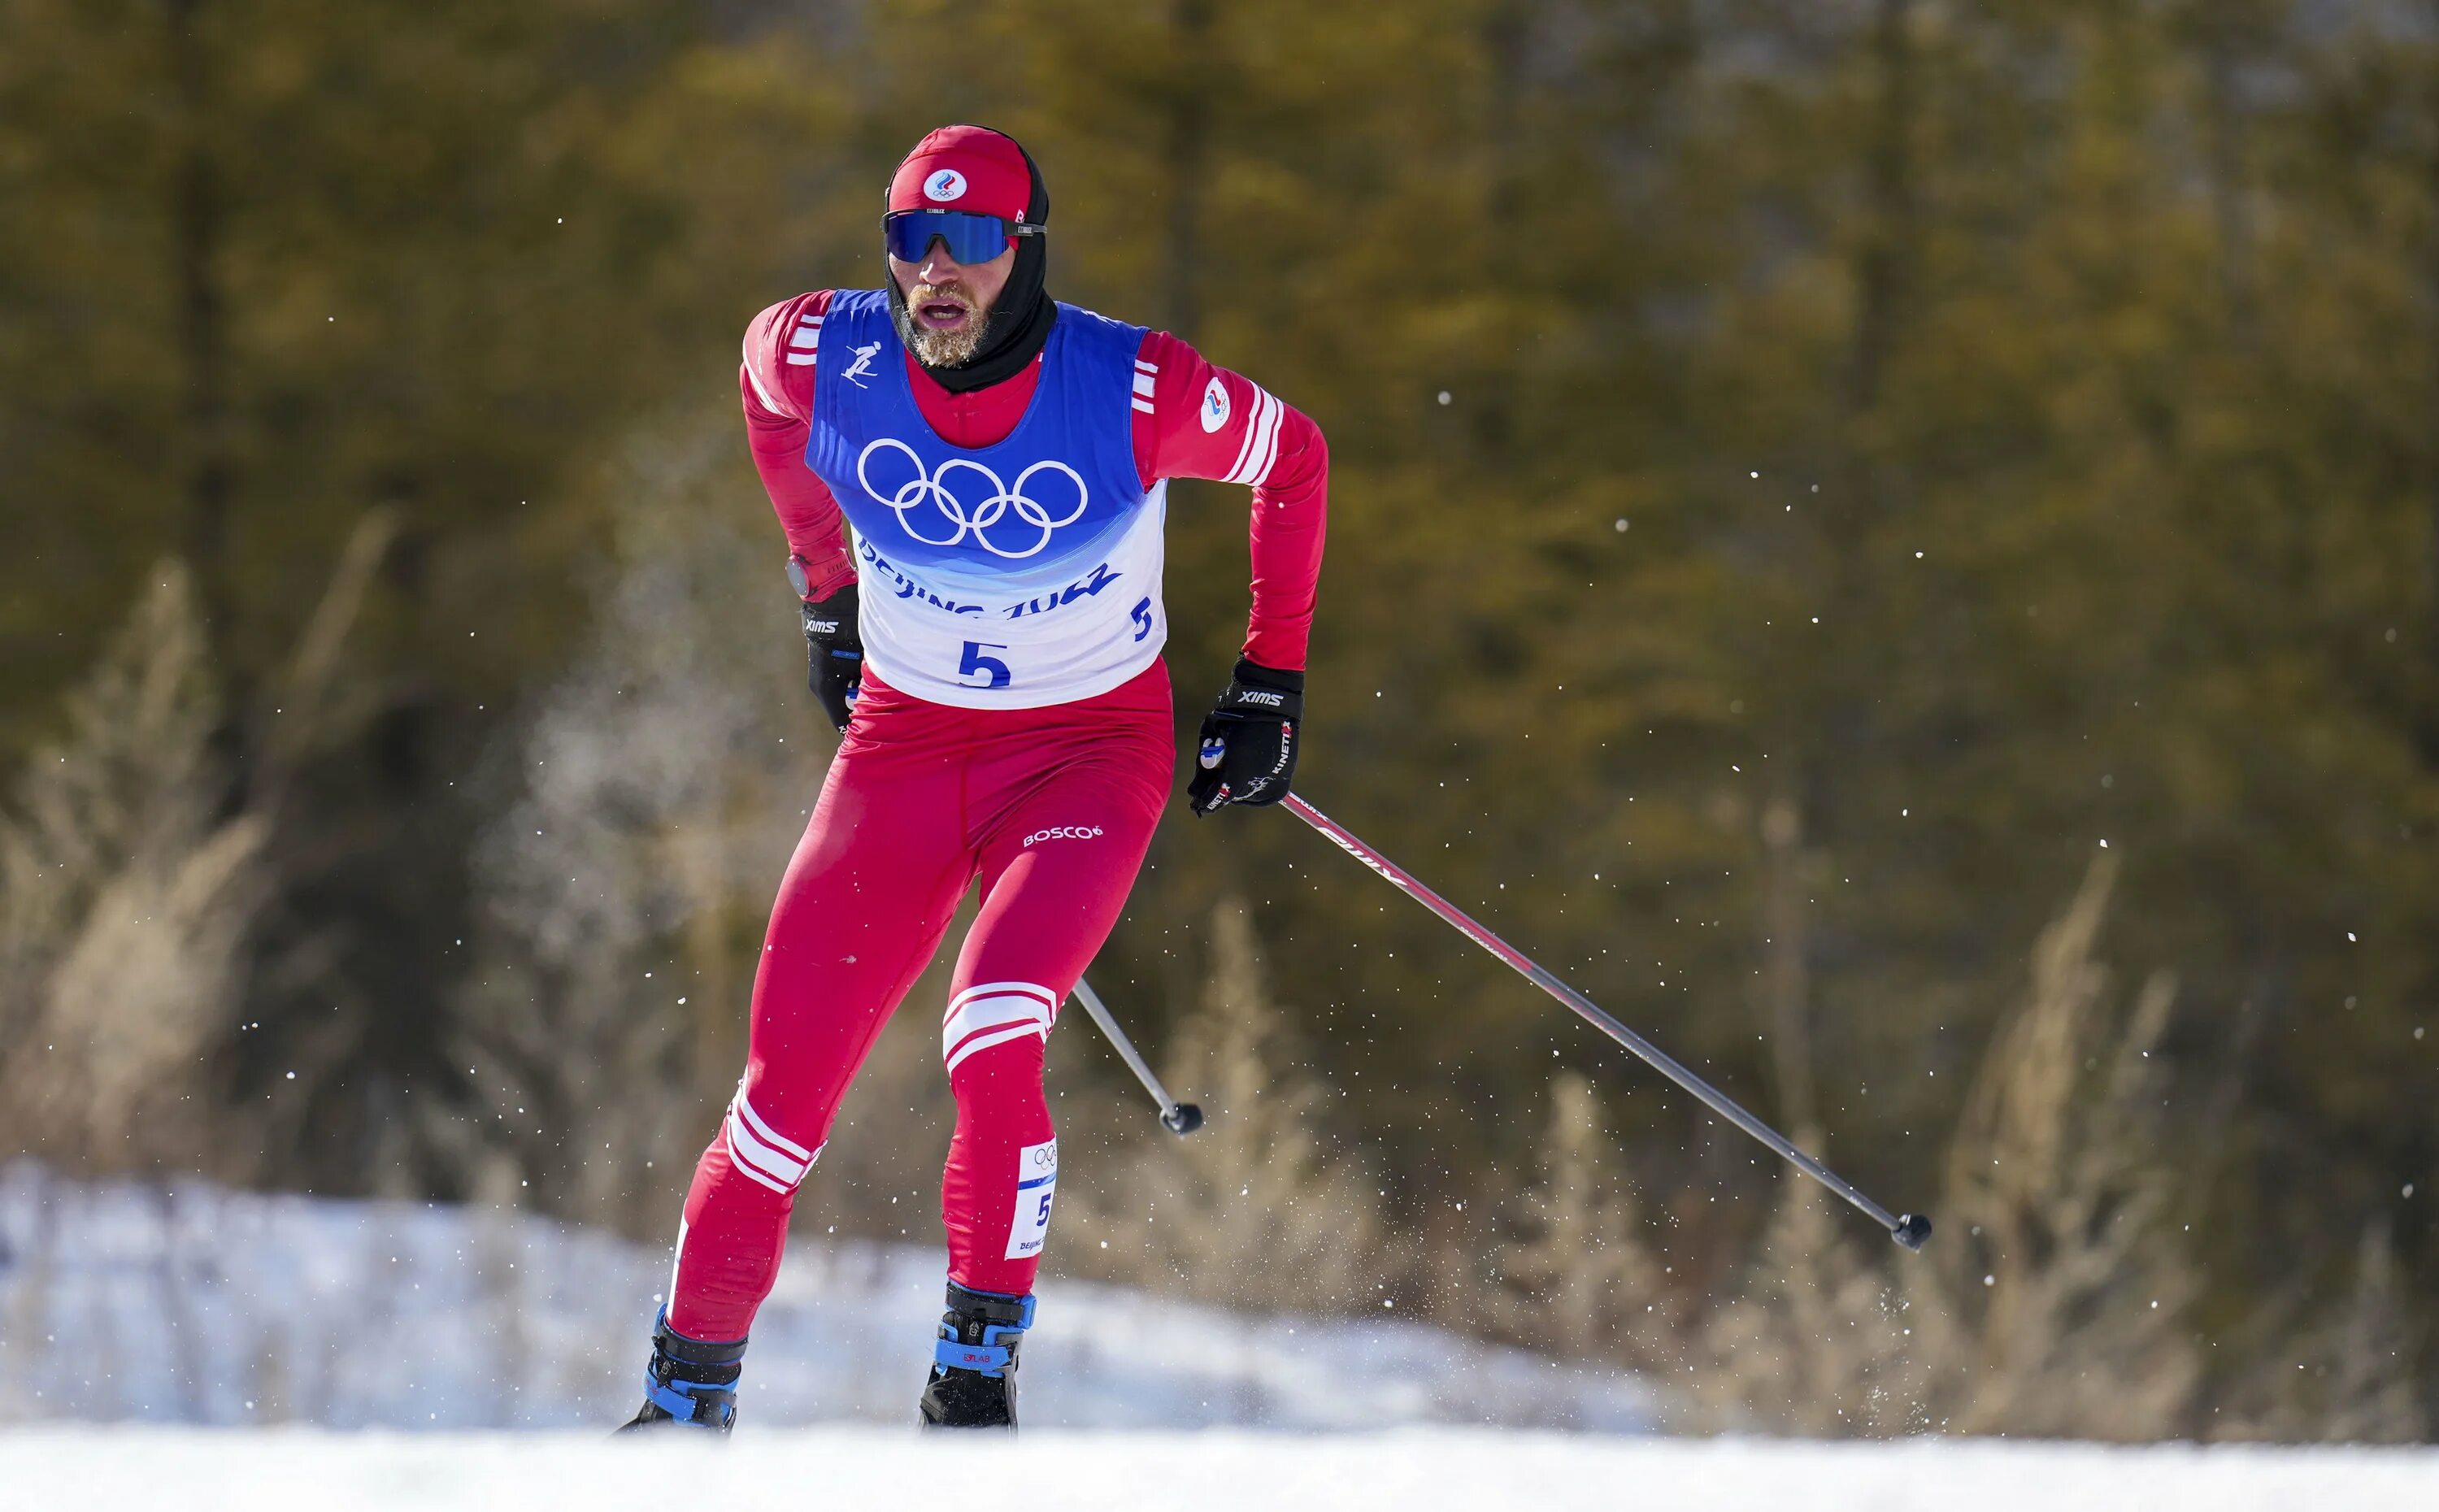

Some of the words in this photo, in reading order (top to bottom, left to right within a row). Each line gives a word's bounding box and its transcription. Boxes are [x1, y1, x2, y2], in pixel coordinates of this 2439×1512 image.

[1130, 597, 1152, 642] 5
[959, 641, 1011, 689] 5
[1024, 826, 1093, 847] BOSCO
[1037, 1193, 1051, 1227] 5
[1020, 1238, 1042, 1251] BEIJING
